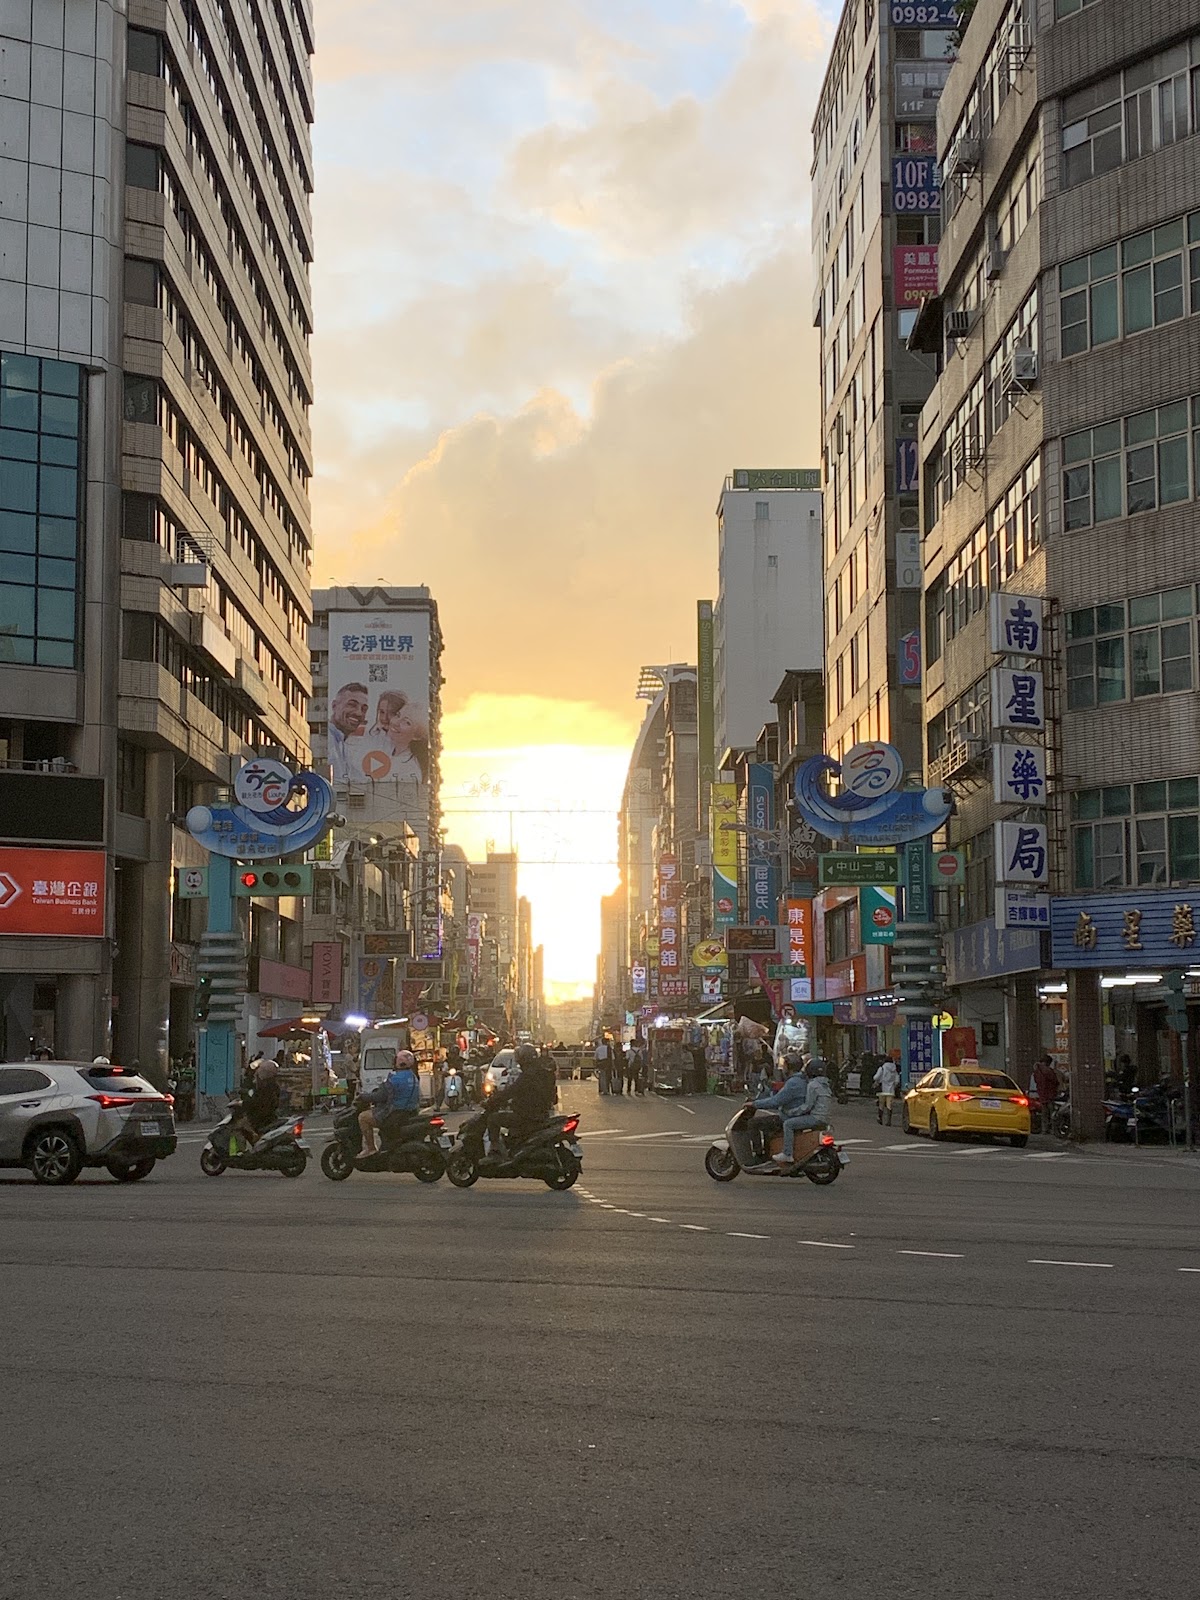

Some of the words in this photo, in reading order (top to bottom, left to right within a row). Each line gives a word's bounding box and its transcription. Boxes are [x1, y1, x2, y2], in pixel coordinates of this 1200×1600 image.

[902, 101, 924, 111] 11F
[895, 160, 929, 188] 10F
[895, 190, 941, 210] 0982
[342, 634, 414, 652] 乾淨世界
[701, 621, 711, 673] Sunnyside
[702, 676, 711, 703] Hotel
[1004, 600, 1045, 880] 南星藥局
[836, 861, 886, 872] 中山一路
[911, 853, 922, 894] 六合二路
[32, 880, 98, 897] 臺灣企銀
[788, 907, 806, 966] 康是美
[322, 945, 332, 976] POYA
